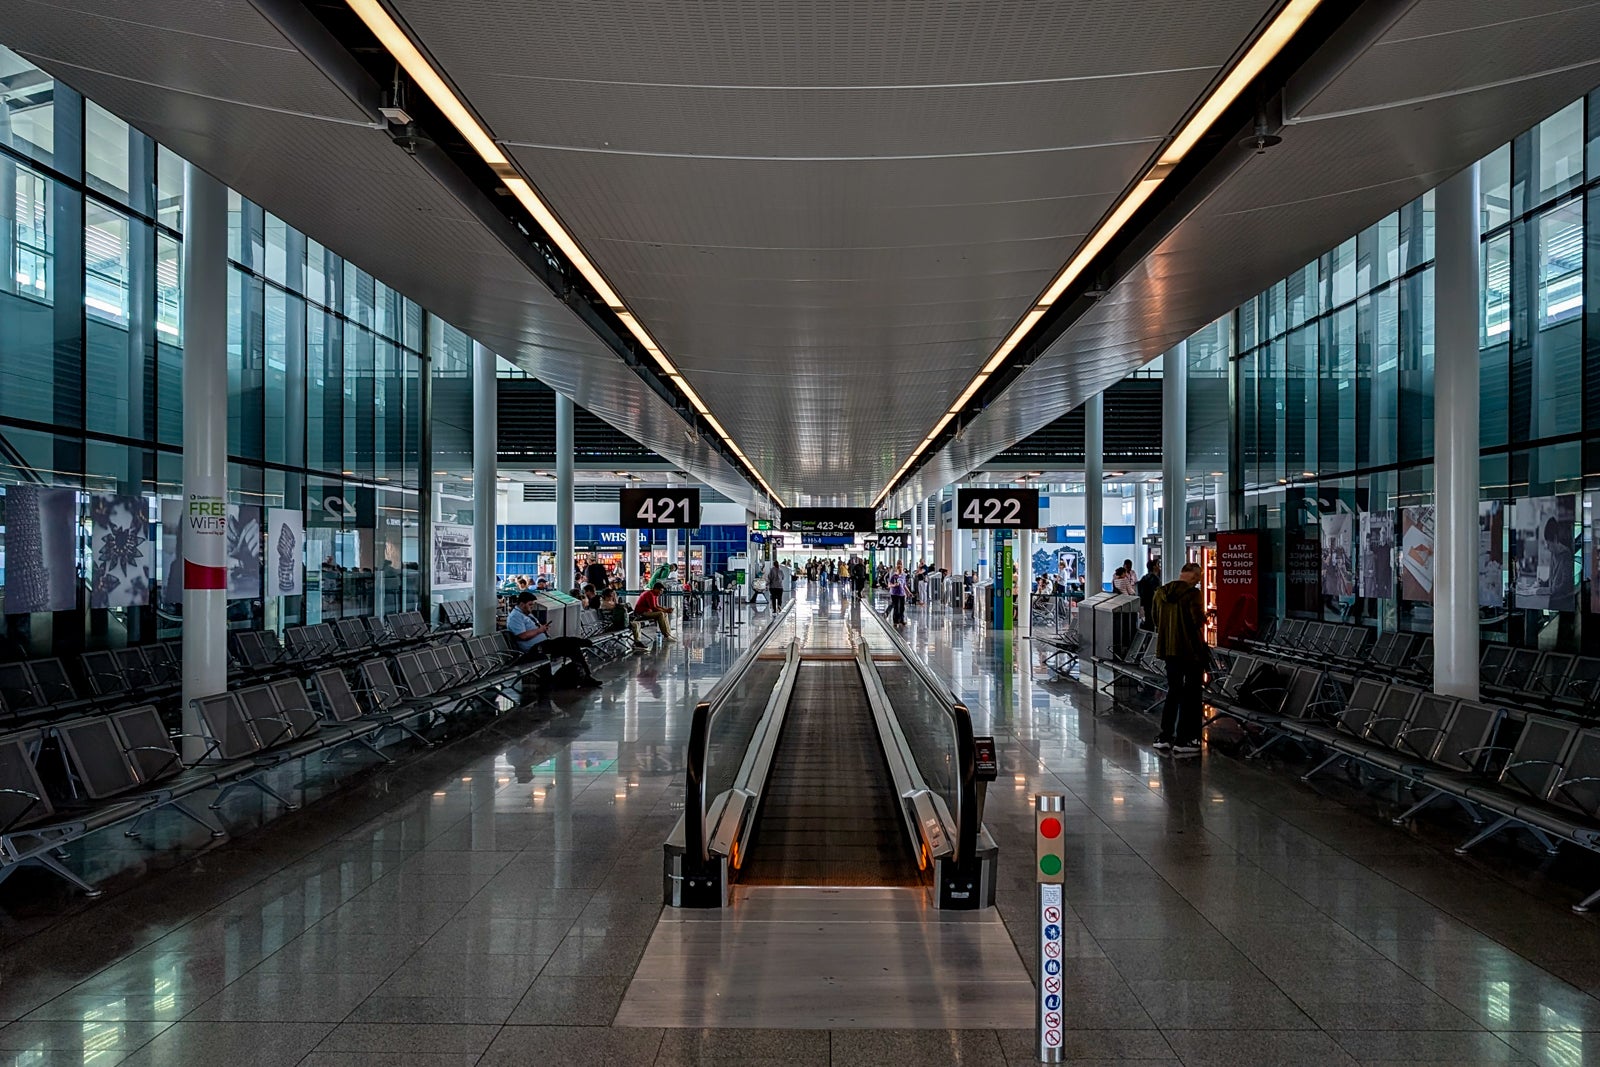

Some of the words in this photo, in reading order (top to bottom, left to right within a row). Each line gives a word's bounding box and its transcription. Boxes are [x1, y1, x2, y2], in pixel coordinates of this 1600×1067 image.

[190, 502, 226, 516] FREE
[637, 498, 690, 523] 421
[963, 498, 1021, 524] 422
[190, 516, 218, 528] WiFi
[817, 521, 855, 530] 423-426
[601, 532, 647, 541] WHSh
[880, 536, 902, 546] 424
